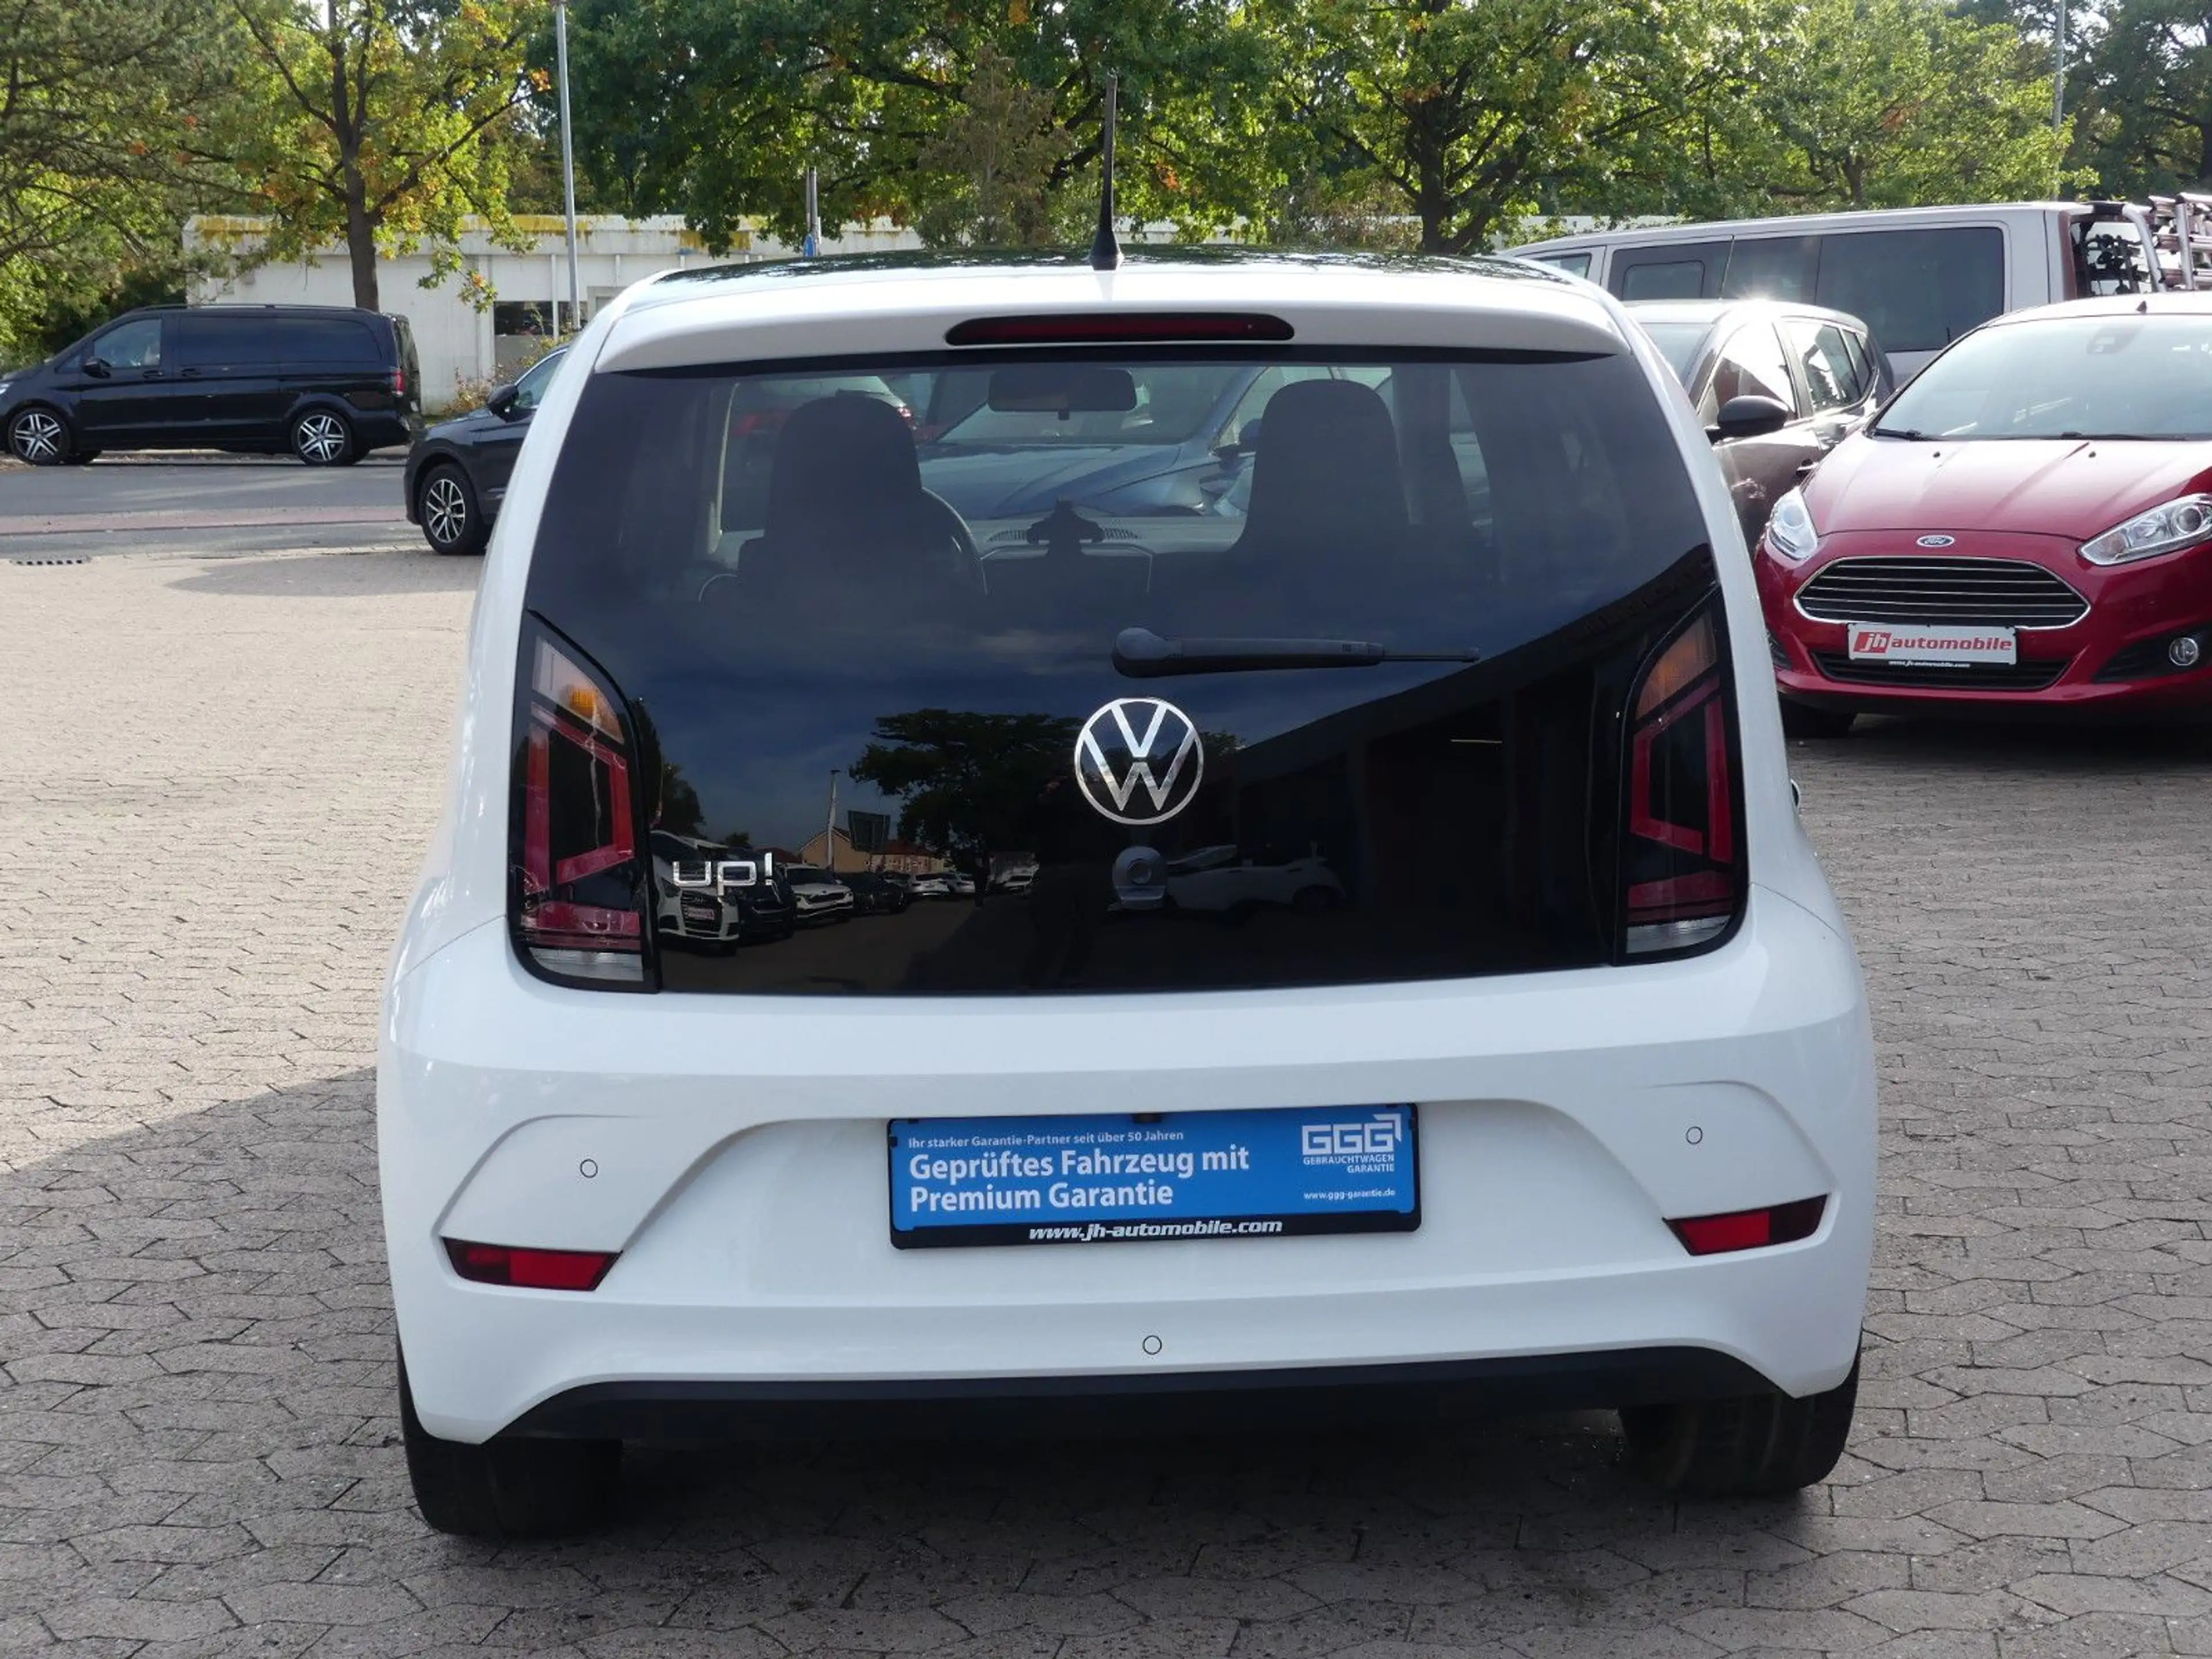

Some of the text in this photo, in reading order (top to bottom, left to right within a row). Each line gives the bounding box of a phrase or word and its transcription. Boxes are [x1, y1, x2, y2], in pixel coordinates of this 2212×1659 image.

[1891, 637, 2012, 651] automobile
[1081, 699, 1197, 812] VW
[672, 852, 772, 896] up!
[908, 1128, 1184, 1149] Ihr starker Garantie-Partner seit über 50 Jahren
[1302, 1122, 1394, 1156] GGG
[910, 1143, 1249, 1185] Geprüftes Fahrzeug mit
[1303, 1154, 1395, 1165] GEBRAUCHTWAGEN
[1347, 1163, 1395, 1173] GARANTIE
[911, 1179, 1173, 1212] Premium Garantie
[1029, 1219, 1283, 1241] www.jh-automobile.com
